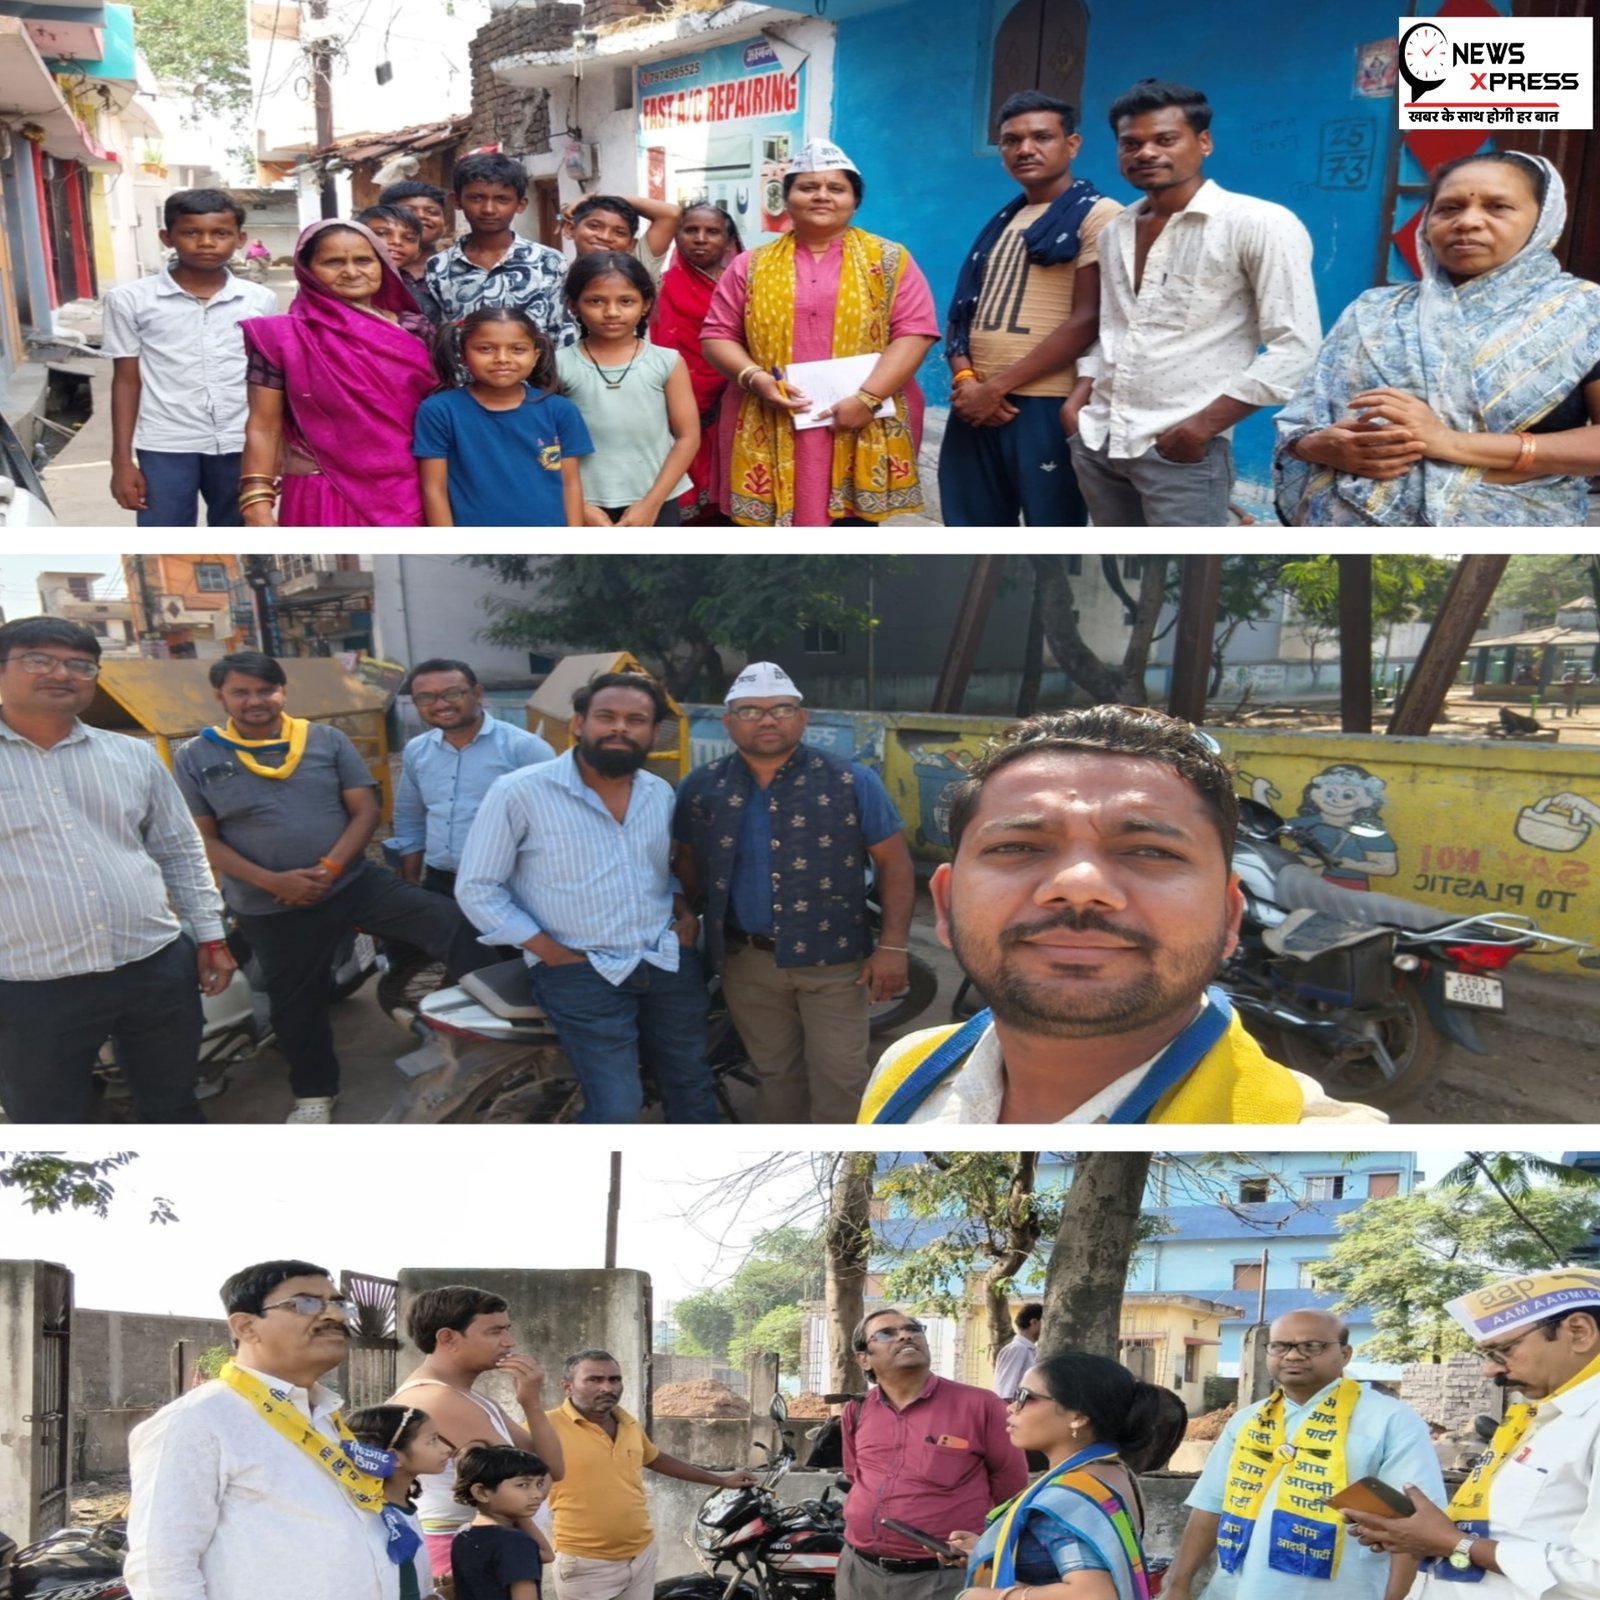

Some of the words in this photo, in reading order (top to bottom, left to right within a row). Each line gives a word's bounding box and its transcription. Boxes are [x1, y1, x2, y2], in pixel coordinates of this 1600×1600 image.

[642, 96, 676, 130] FAST
[676, 87, 704, 124] A/C
[705, 72, 798, 124] REPAIRING
[1329, 122, 1368, 148] 25
[1327, 154, 1368, 185] 73
[1476, 1279, 1535, 1308] aap
[1493, 1305, 1530, 1326] AAM
[1534, 1289, 1586, 1310] AADMI
[1238, 1460, 1266, 1478] आम
[1295, 1460, 1328, 1477] आम
[1284, 1475, 1335, 1496] आदमी
[1289, 1494, 1328, 1513] पार्टी
[1291, 1522, 1320, 1540] आम
